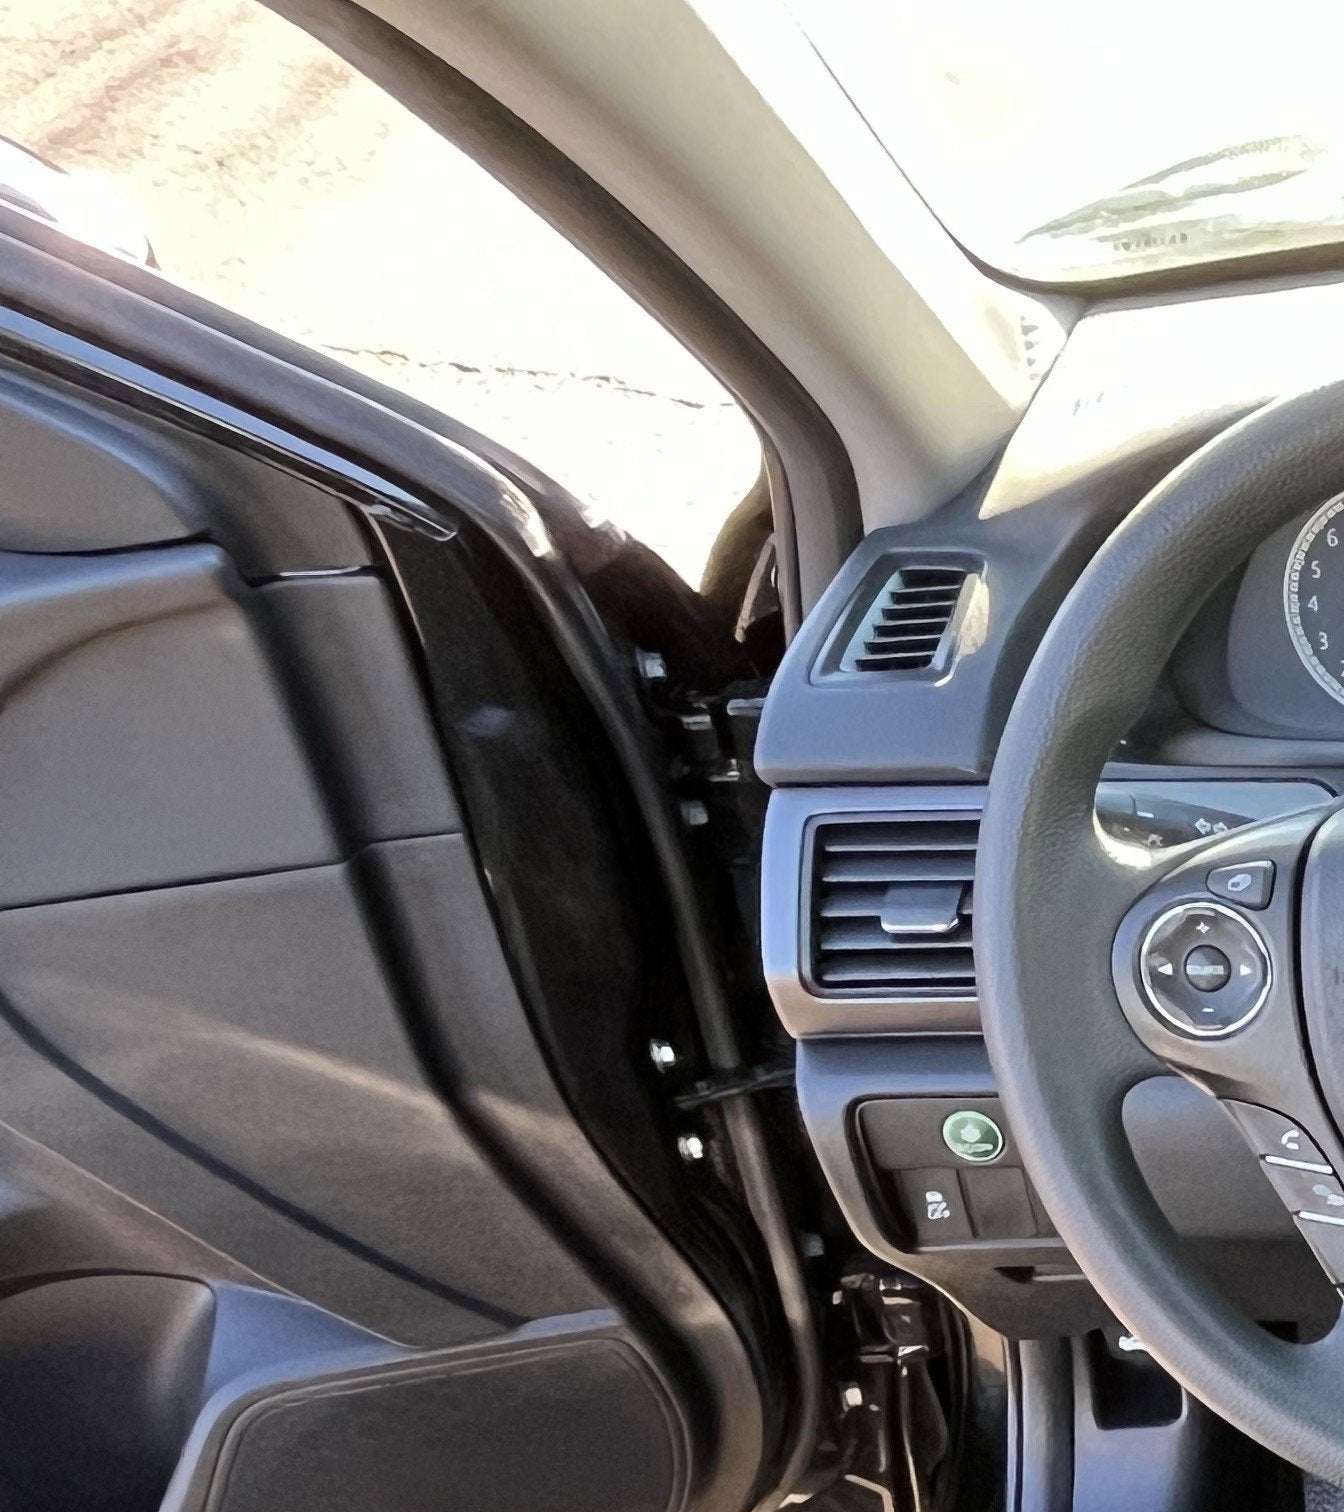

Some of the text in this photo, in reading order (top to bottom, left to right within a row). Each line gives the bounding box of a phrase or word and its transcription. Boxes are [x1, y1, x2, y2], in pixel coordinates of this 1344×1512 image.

[1327, 528, 1338, 547] 6
[1311, 561, 1320, 578] 5
[1308, 595, 1318, 611] 4
[1319, 632, 1328, 650] 3
